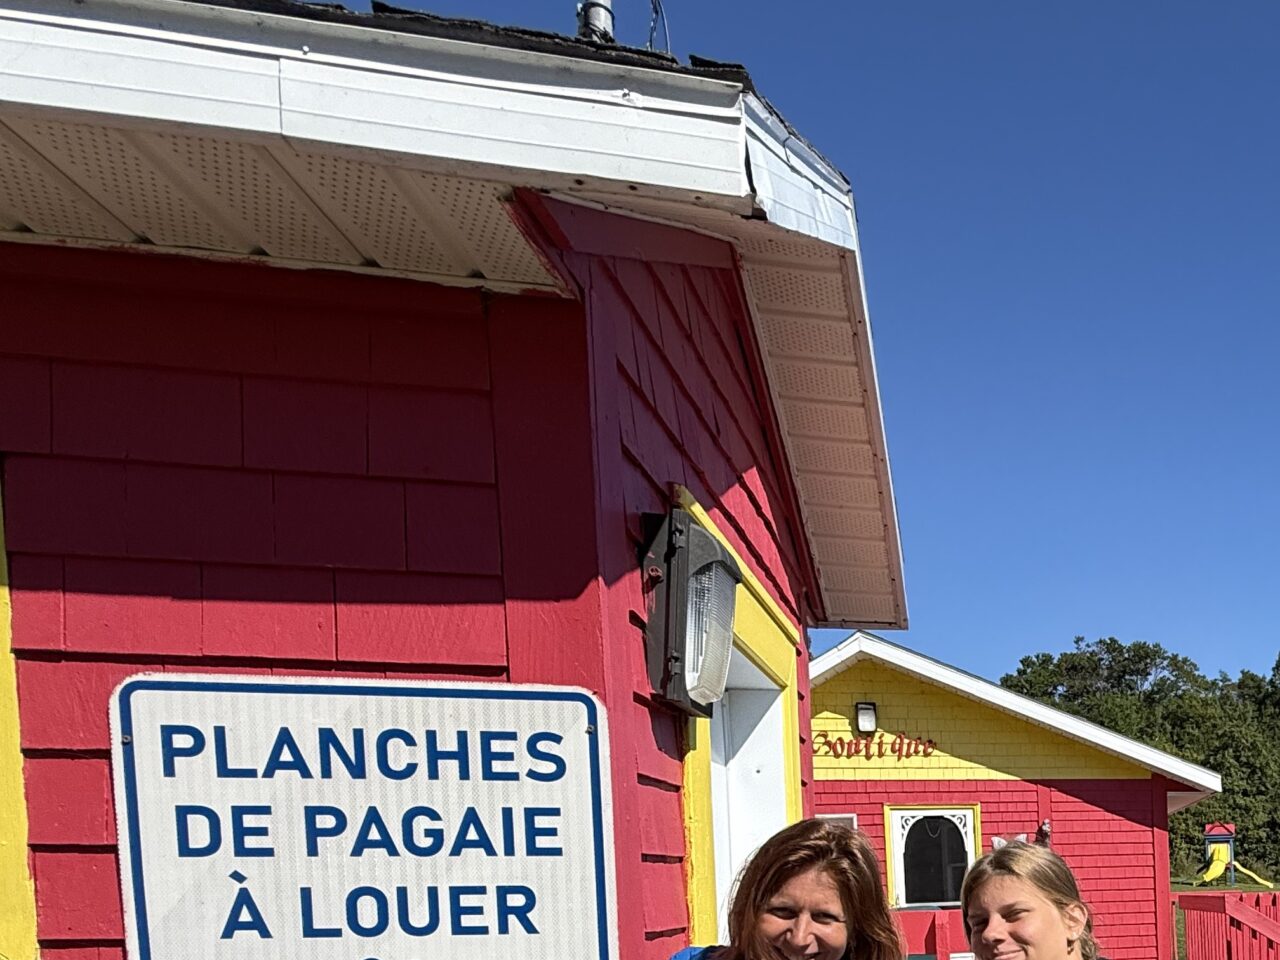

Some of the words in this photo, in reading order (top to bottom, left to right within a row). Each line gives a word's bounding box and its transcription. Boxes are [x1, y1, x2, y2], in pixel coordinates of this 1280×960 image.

[160, 725, 567, 782] PLANCHES
[812, 730, 937, 762] Boutique
[175, 805, 275, 858] DE
[304, 805, 563, 858] PAGAIE
[220, 870, 273, 939] À
[300, 885, 539, 939] LOUER
